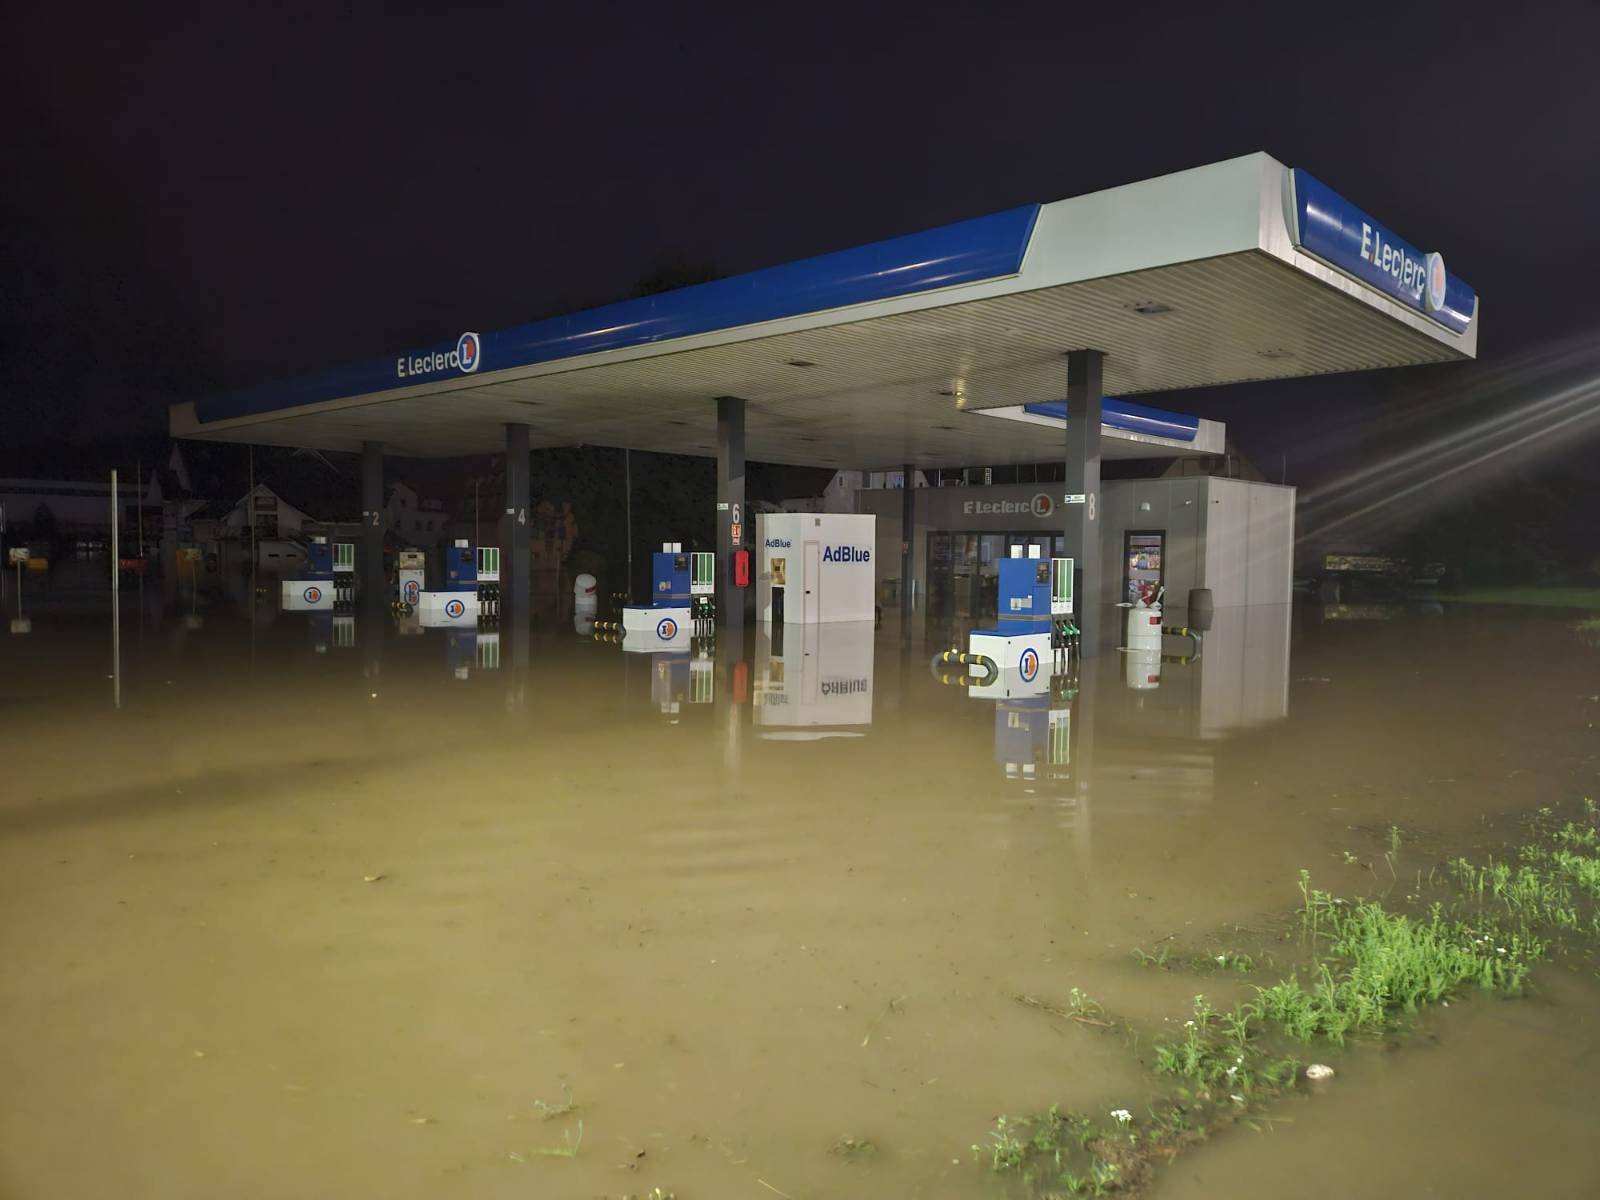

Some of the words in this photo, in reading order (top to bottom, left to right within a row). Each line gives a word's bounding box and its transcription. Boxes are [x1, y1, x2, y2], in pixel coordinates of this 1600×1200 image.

[1360, 222, 1426, 291] E.Leclerc
[732, 503, 740, 524] 6
[1088, 492, 1096, 521] 8
[372, 511, 380, 526] 2
[518, 508, 526, 526] 4
[765, 538, 791, 548] AdBlue
[822, 545, 870, 562] AdBlue
